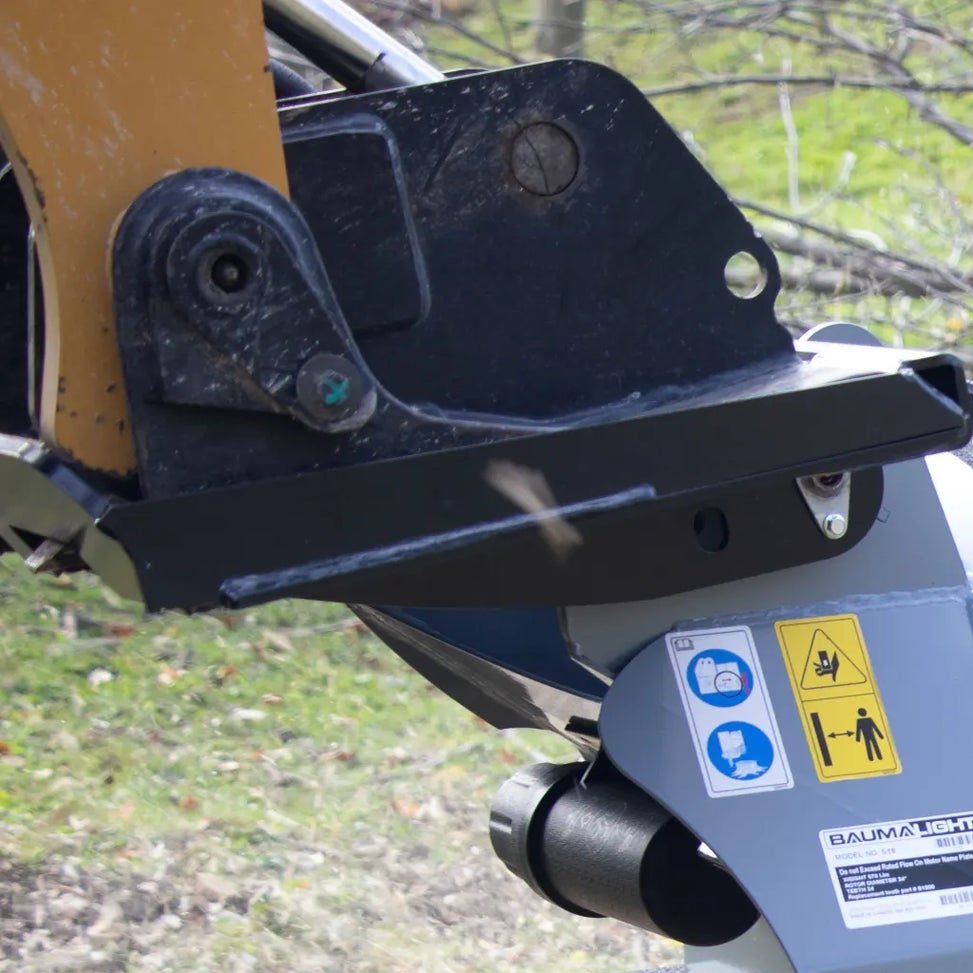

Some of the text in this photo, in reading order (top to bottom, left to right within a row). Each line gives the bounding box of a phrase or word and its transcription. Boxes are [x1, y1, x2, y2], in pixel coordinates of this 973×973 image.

[835, 852, 862, 860] MODEL
[859, 864, 880, 872] Exceed
[924, 856, 940, 865] Motor
[942, 854, 958, 862] Name
[958, 852, 973, 860] Plate
[867, 877, 896, 885] DIAMETER
[848, 891, 884, 900] Replacement
